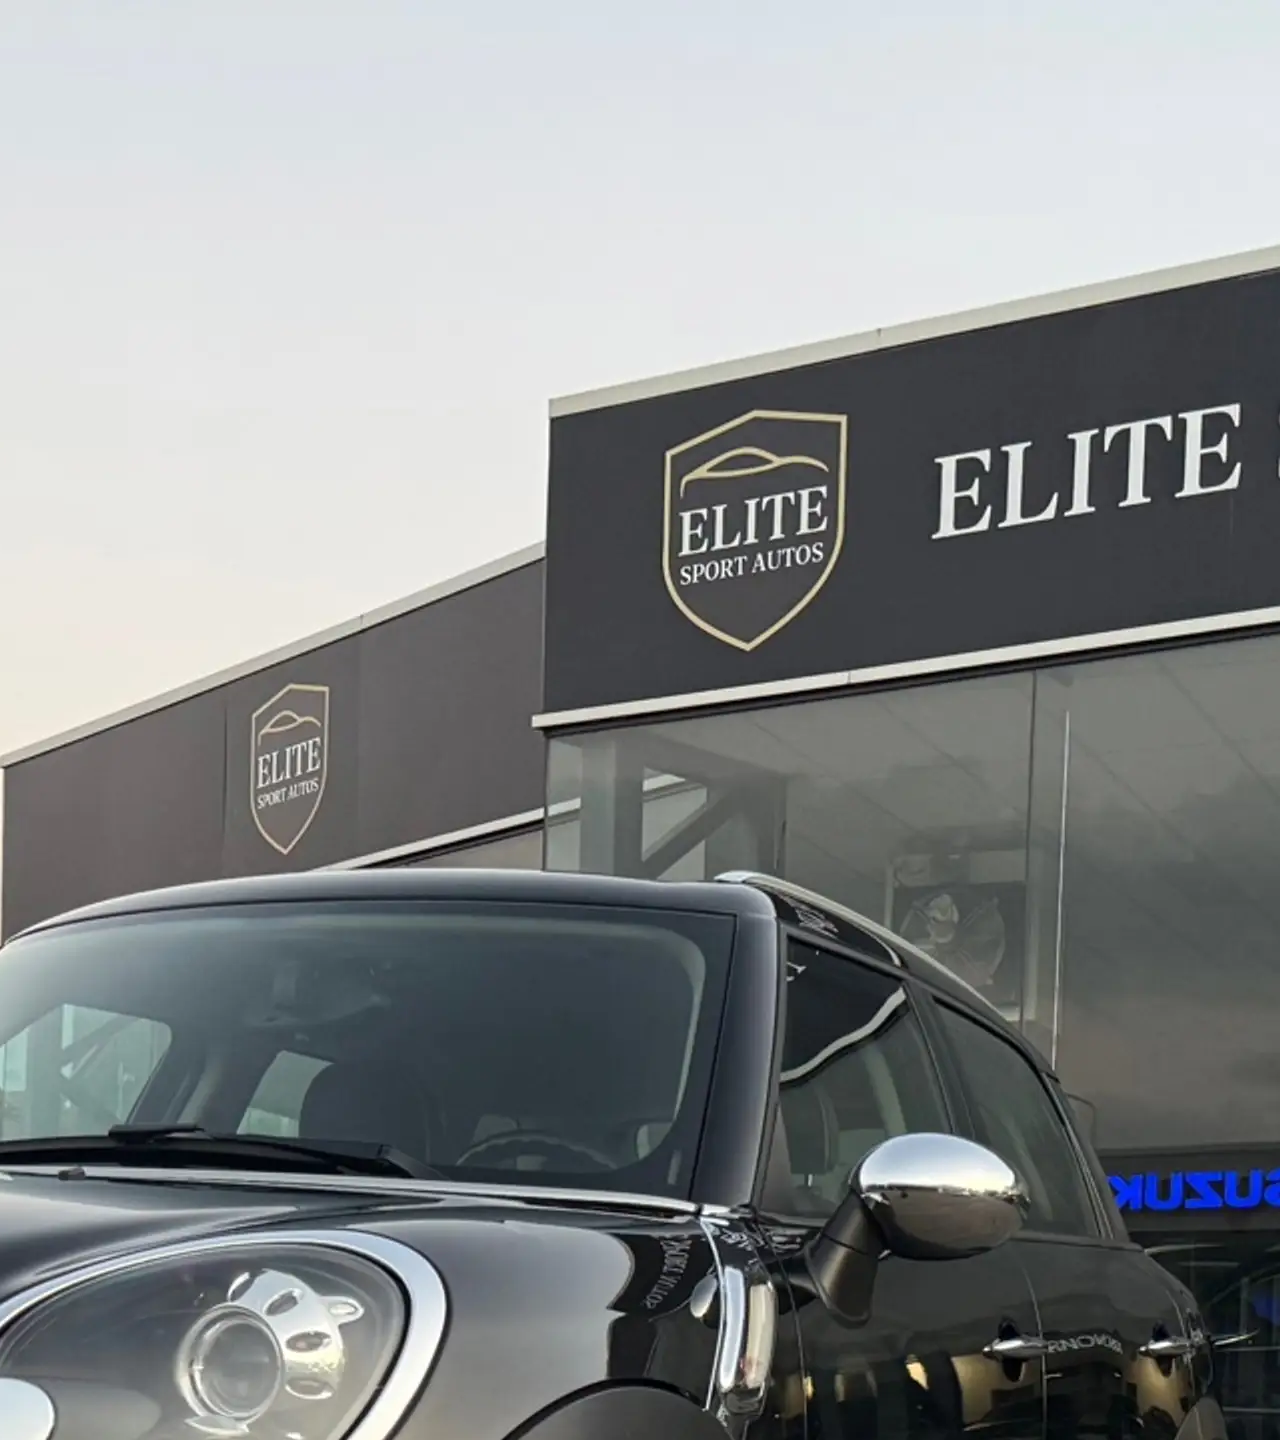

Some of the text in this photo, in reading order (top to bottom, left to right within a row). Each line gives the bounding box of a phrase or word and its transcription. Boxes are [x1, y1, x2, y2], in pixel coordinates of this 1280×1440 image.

[931, 403, 1242, 540] ELITE
[677, 485, 828, 558] ELITE
[679, 541, 824, 586] SPORT AUTOS
[256, 736, 321, 789] ELITE
[257, 777, 319, 810] SPORT AUTOS
